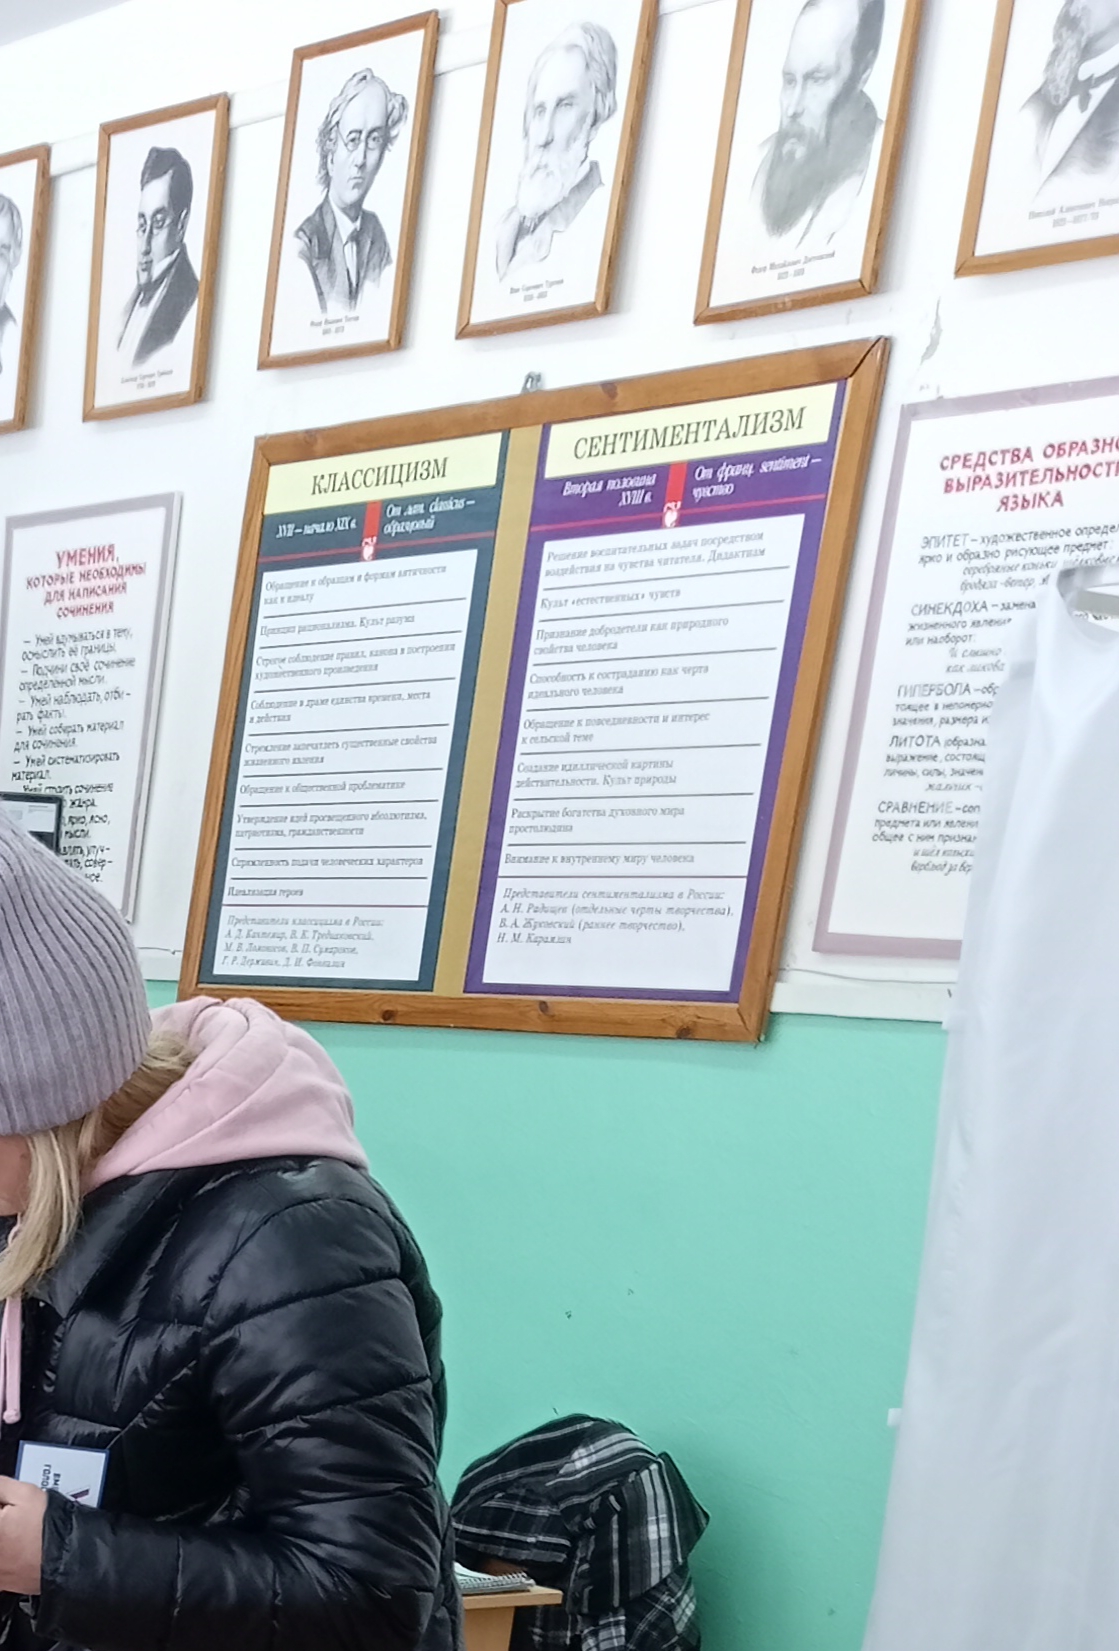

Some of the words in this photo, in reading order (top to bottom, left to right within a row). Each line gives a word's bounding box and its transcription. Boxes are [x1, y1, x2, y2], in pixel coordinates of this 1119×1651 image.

[573, 405, 808, 460] СЕНТИМЕНТАЛИЗМ
[939, 446, 1034, 472] СРЕДСТВА
[311, 456, 449, 495] КЛАССИЦИЗМ
[995, 490, 1065, 513] ЯЗЫКА
[921, 533, 970, 549] ЭПИТЕТ
[981, 528, 1072, 546] художественное
[56, 544, 119, 569] УМЕНИЯ,
[1004, 545, 1060, 561] рисующее
[26, 571, 74, 590] КОТОРЫЕ
[79, 564, 145, 582] НЕОБХОДИМЫ
[43, 589, 65, 606] ДЛЯ
[68, 581, 127, 601] НАПИСАНИЯ
[56, 601, 114, 619] СОЧИНЕНИЯ
[911, 600, 988, 617] СИНЕКДОХА
[897, 682, 971, 698] ГИПЕРБОЛА
[889, 734, 941, 748] ЛИТОТА
[878, 800, 952, 814] СРАВНЕНИЕ
[40, 1463, 52, 1491] ГОЛО
